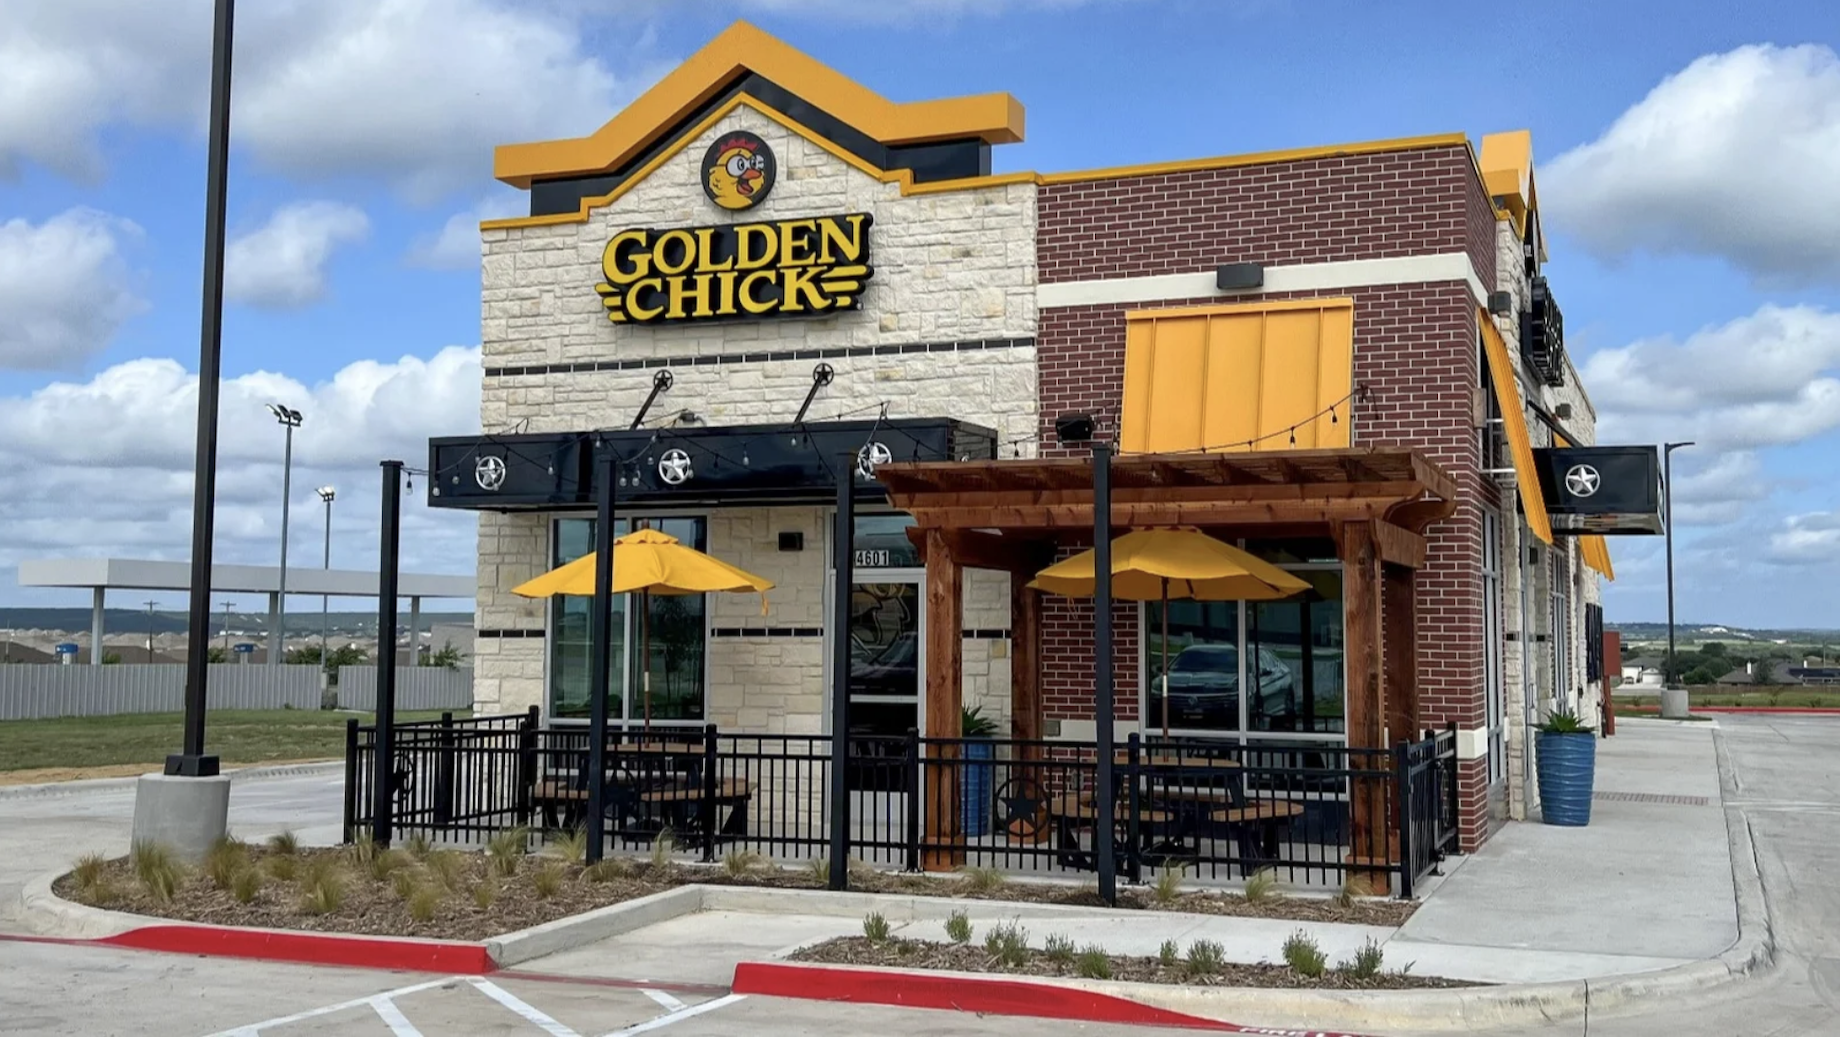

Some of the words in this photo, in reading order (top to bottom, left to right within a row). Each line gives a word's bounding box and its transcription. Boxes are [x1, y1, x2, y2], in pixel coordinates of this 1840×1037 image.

[602, 215, 865, 284] GOLDEN
[626, 266, 832, 320] CHICK
[856, 550, 887, 566] 4601
